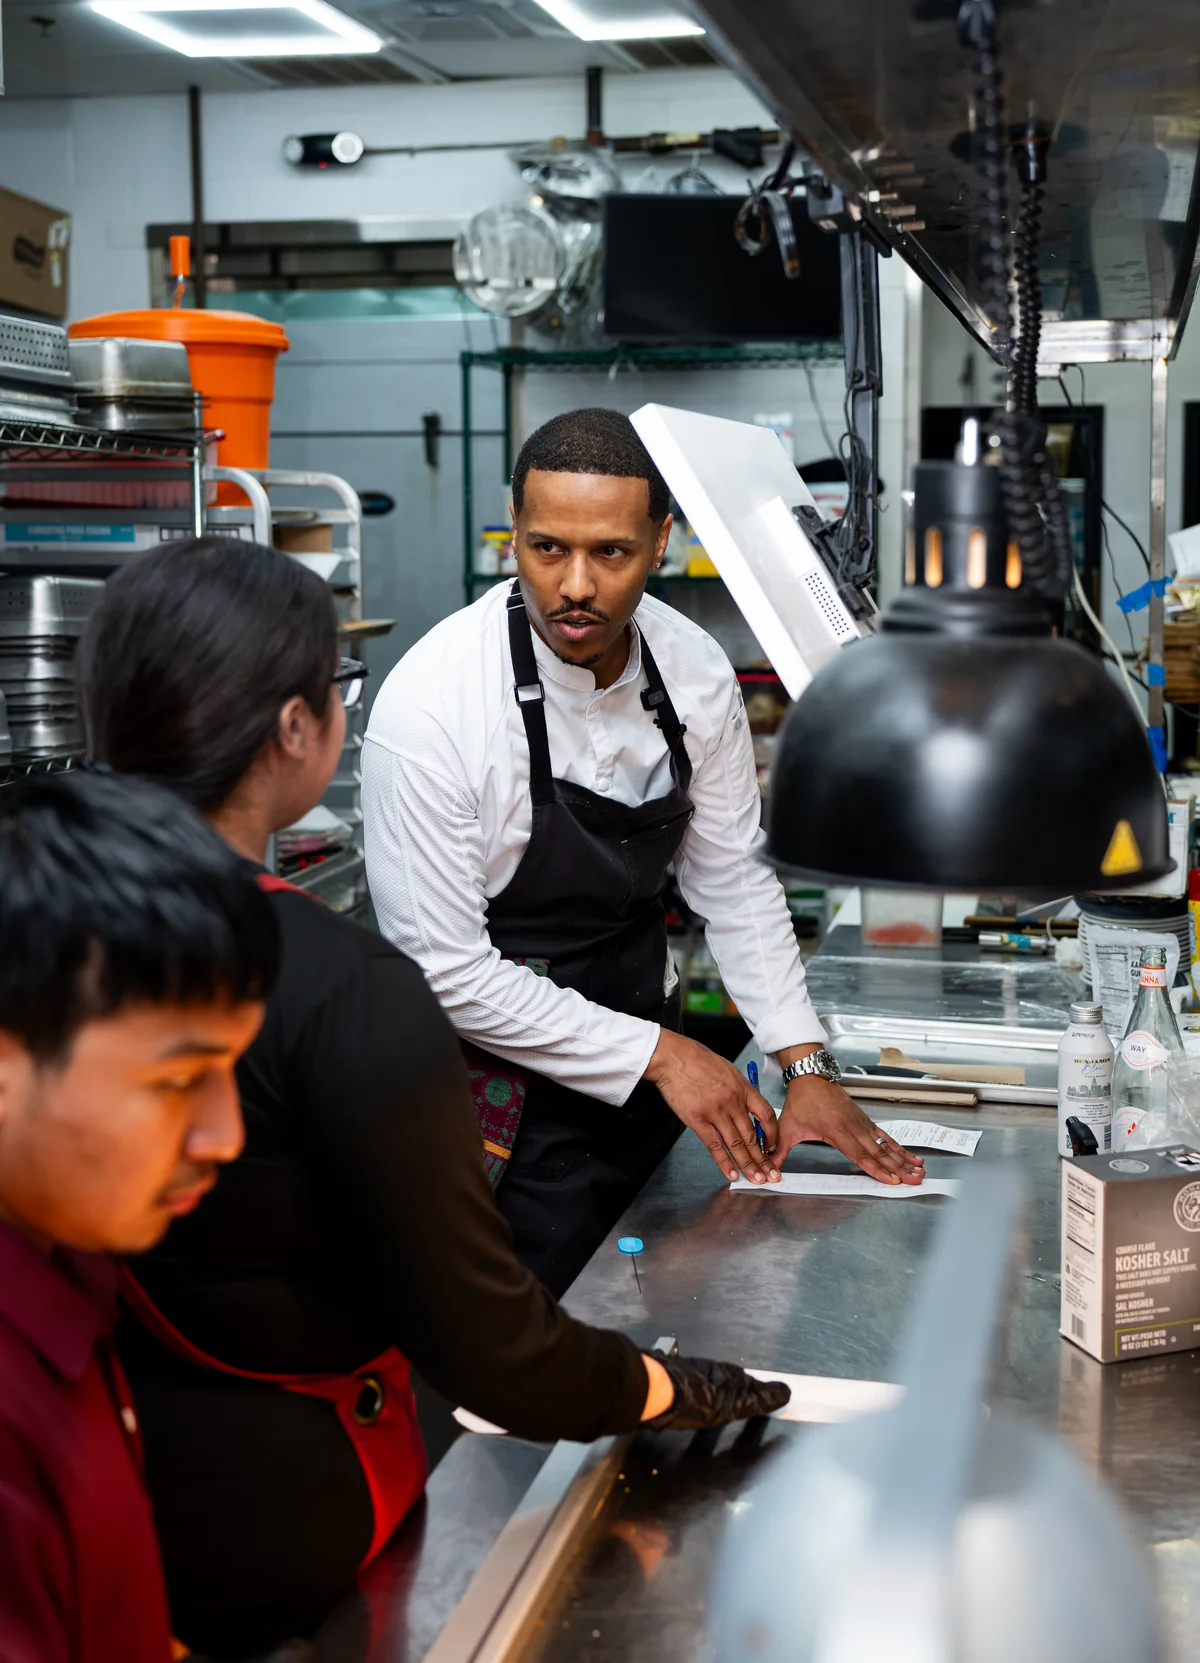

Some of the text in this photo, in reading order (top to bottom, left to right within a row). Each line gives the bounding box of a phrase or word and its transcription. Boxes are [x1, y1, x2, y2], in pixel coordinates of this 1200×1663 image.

[1130, 1044, 1146, 1053] WAY
[1138, 1242, 1155, 1252] FLAKE
[1116, 1247, 1190, 1272] KOSHER SALT
[1115, 1298, 1154, 1312] SAL KOSHER
